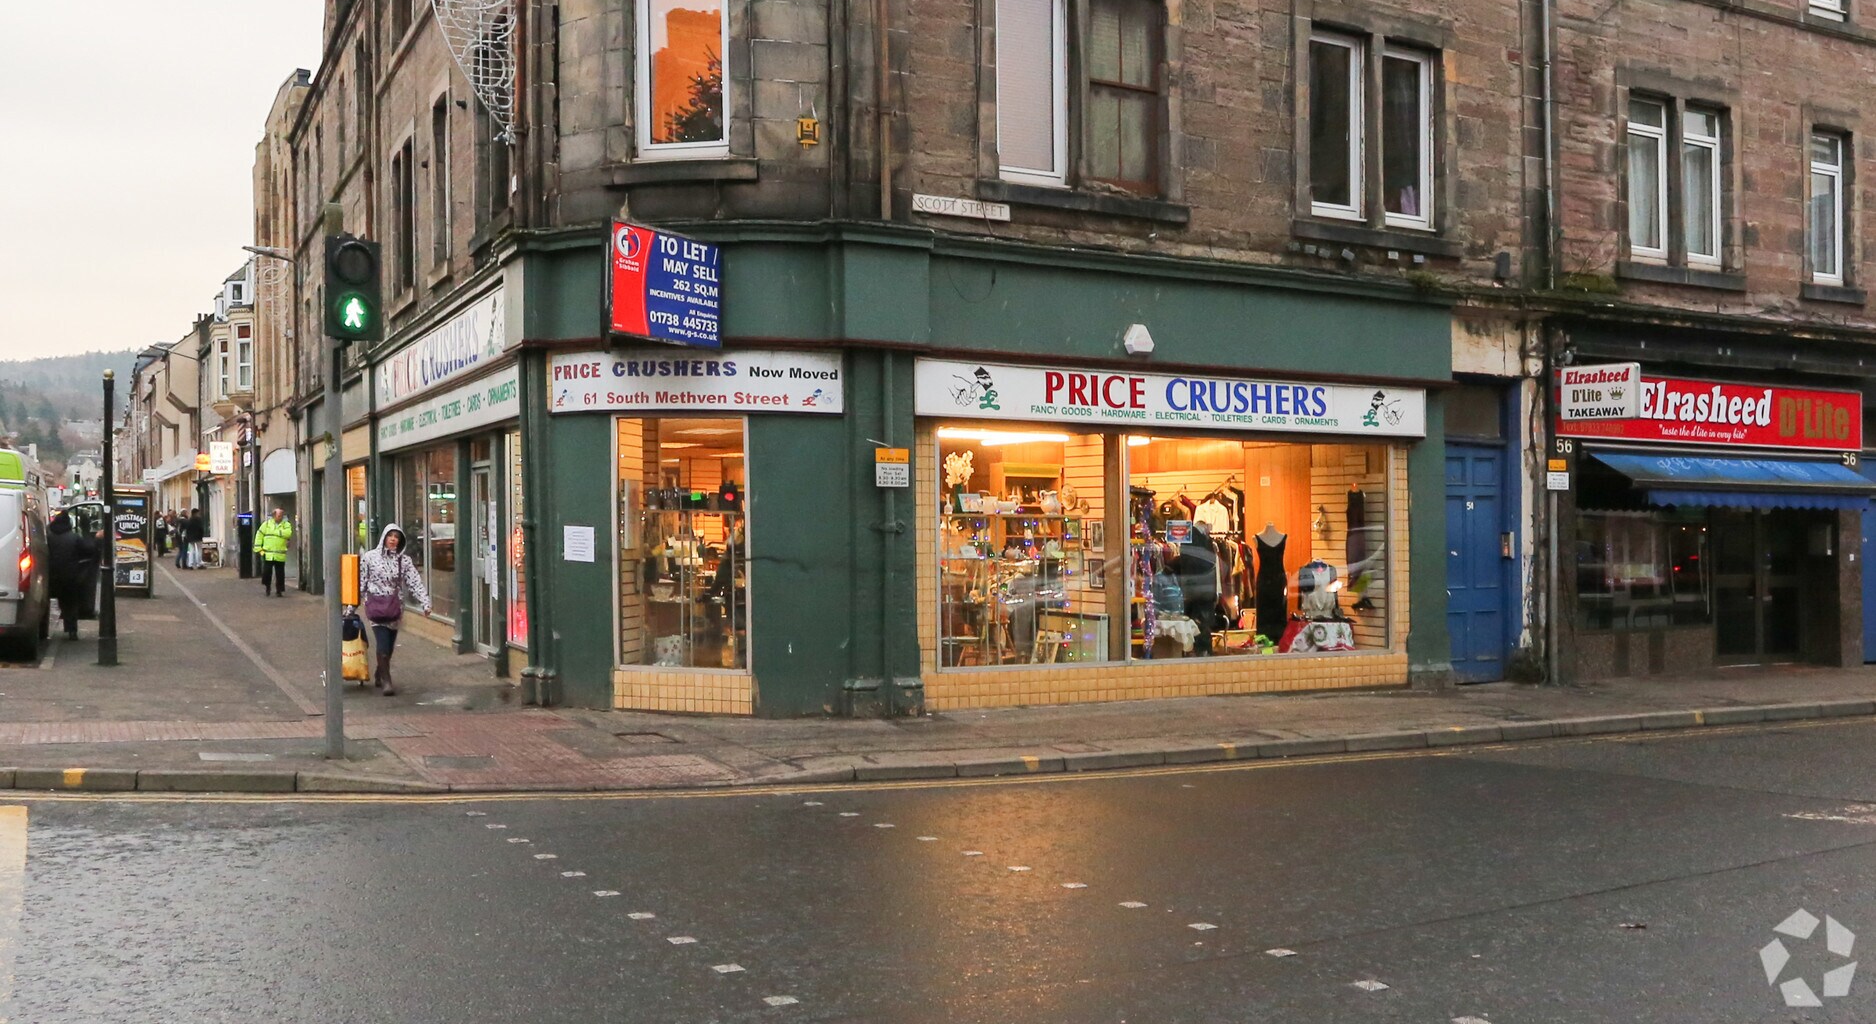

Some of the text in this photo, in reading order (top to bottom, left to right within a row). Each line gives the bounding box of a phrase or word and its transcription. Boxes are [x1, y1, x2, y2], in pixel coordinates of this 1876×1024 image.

[918, 197, 1005, 217] SCOTT STREET
[659, 235, 678, 255] TO
[683, 241, 707, 262] LET
[663, 258, 718, 282] MAY SELL
[673, 279, 718, 297] 262 SQ.M
[649, 289, 718, 308] INCENTIVES AVAILABLE
[649, 311, 718, 332] 01738 445733
[668, 327, 718, 341] www.g-s.co.uk
[421, 310, 479, 386] CRUSHERS
[554, 360, 839, 381] PRICE CRUSHERS Now Moved
[1564, 368, 1630, 385] Elrasheed
[584, 391, 789, 406] 61 South Methven Street
[1045, 371, 1327, 417] PRICE CRUSHERS
[1572, 389, 1602, 403] D'Lite
[1030, 404, 1339, 427] FANCY GOODS HARDWARE ELECTRICAL TOILETRIES CARDS ORNAMENTS
[1568, 406, 1625, 417] TAKEAWAY
[1640, 381, 1850, 440] Elrasheed D'Lite
[1679, 425, 1690, 436] the
[1556, 439, 1573, 453] 56
[1843, 453, 1857, 466] 56
[119, 522, 140, 530] LUNCH
